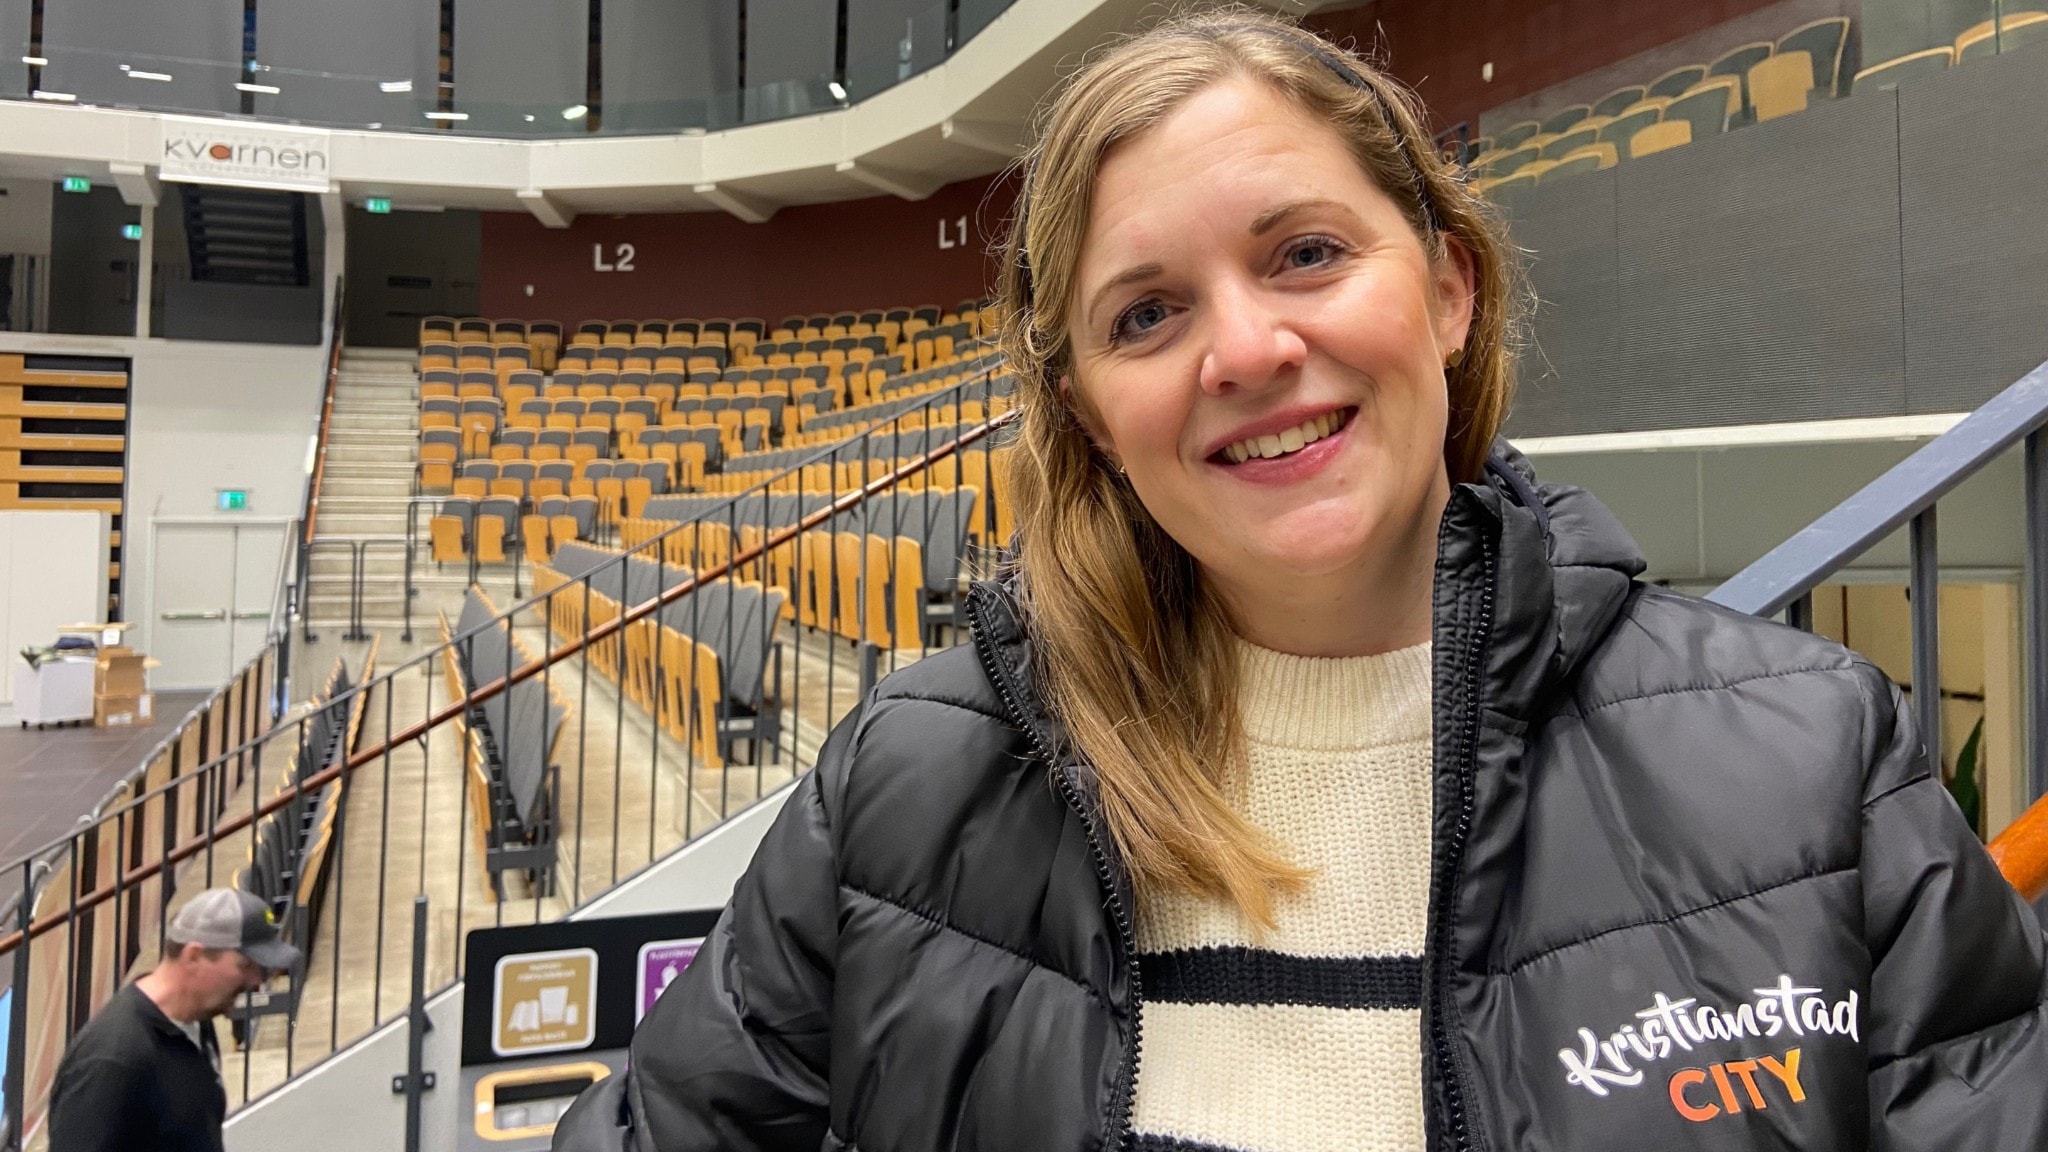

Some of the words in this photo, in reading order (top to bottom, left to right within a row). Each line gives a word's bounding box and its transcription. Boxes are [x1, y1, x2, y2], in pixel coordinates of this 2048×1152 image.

[164, 138, 326, 170] kvarnen
[937, 215, 968, 250] L1
[592, 243, 635, 272] L2
[1558, 973, 1859, 1097] Kristianstad
[1668, 1047, 1806, 1122] CITY
